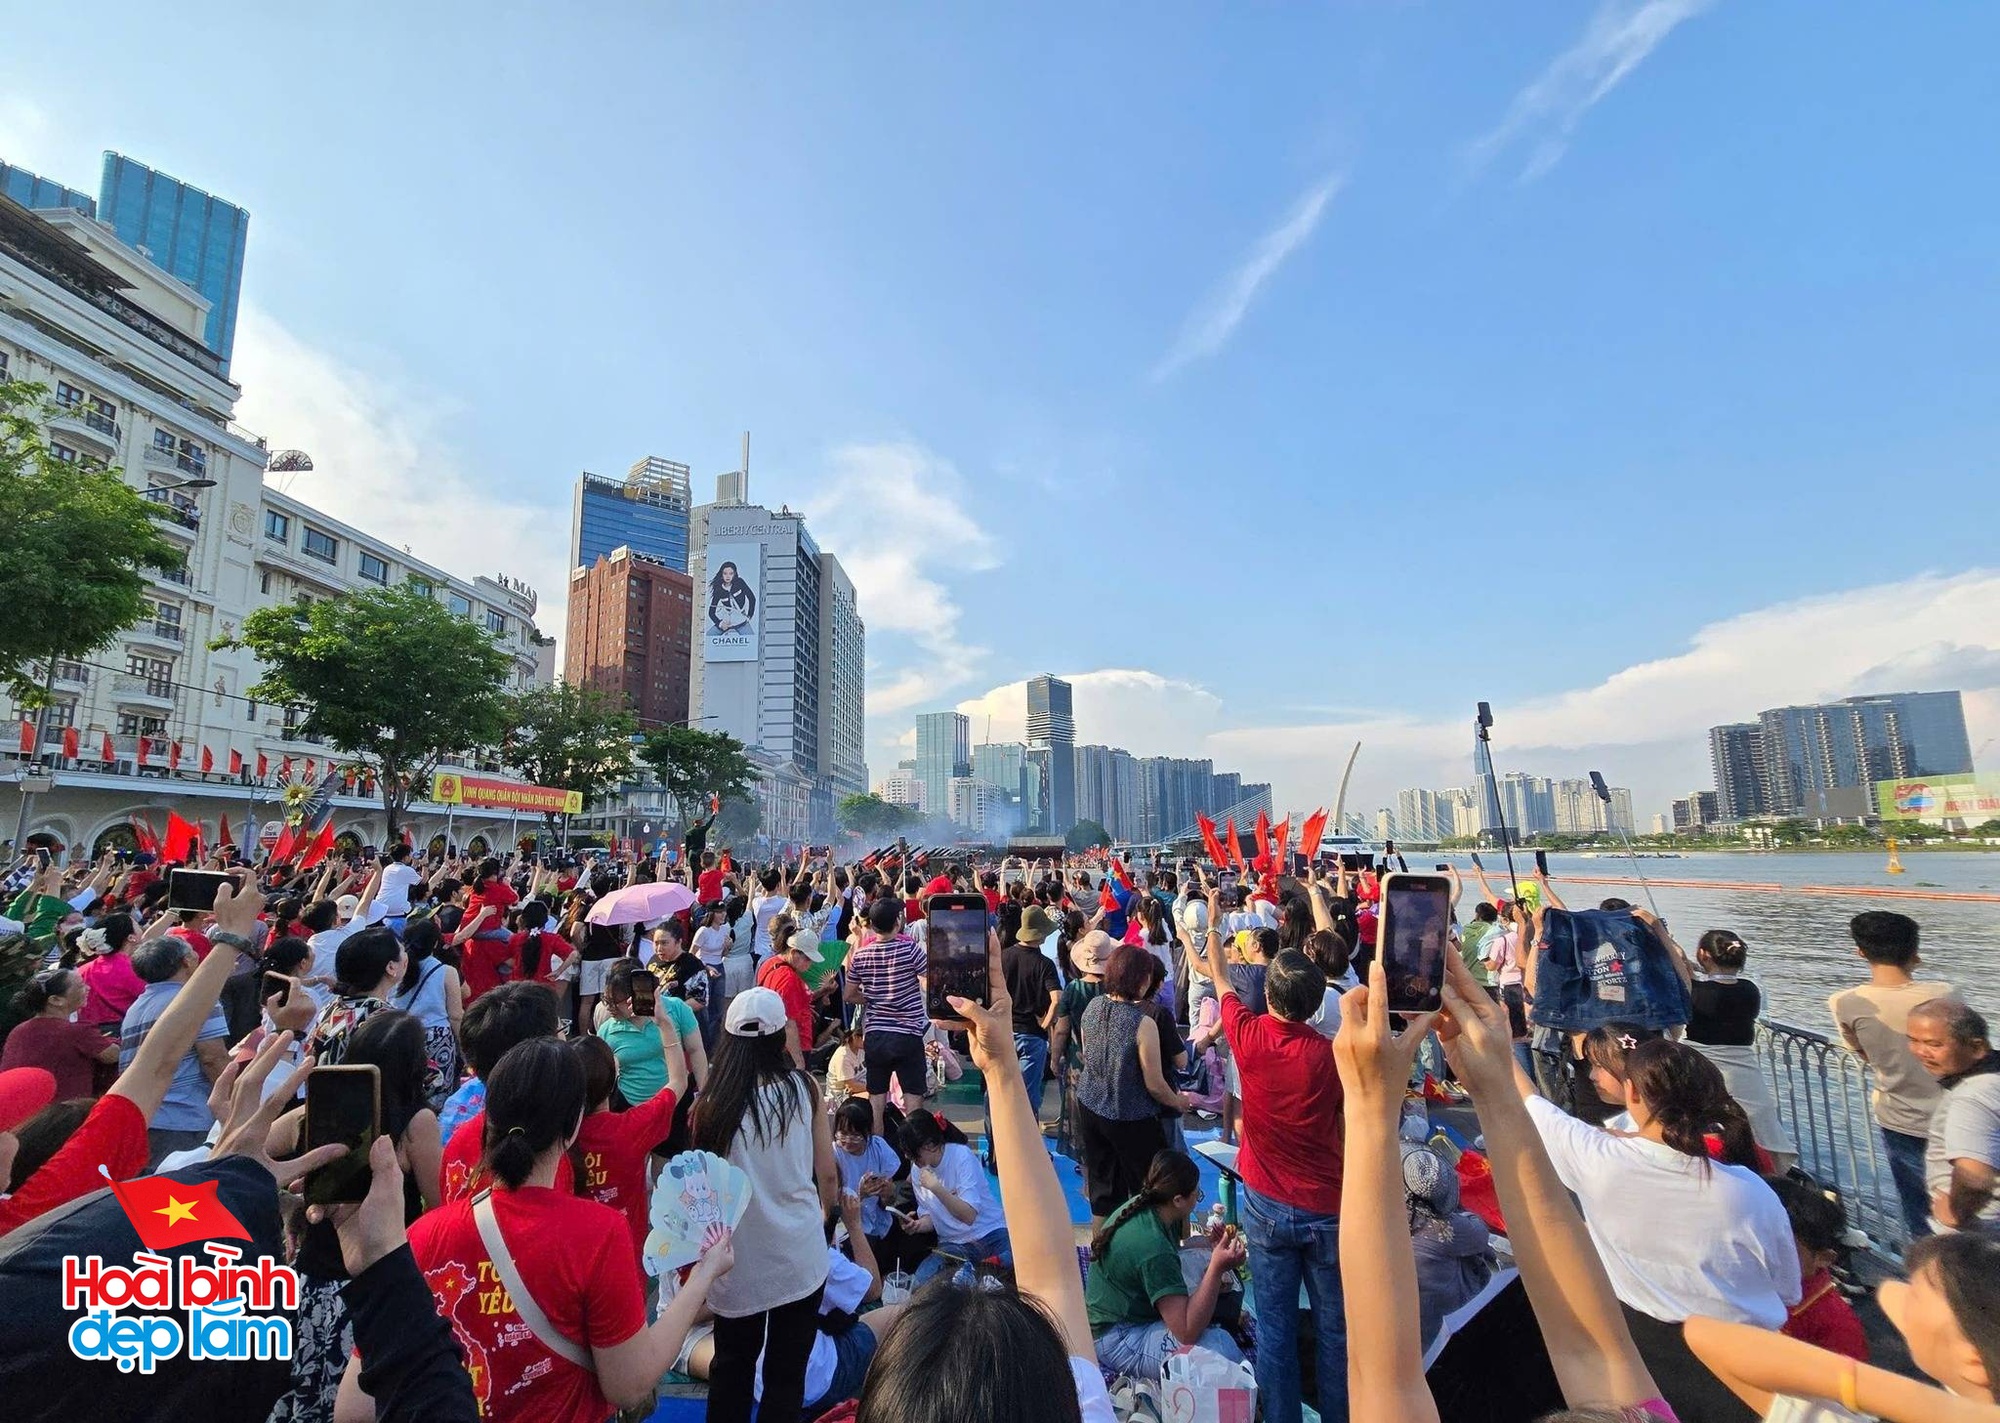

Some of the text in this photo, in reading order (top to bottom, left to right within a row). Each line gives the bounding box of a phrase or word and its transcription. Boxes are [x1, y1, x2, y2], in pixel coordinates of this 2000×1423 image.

[712, 637, 750, 645] CHANEL
[585, 1152, 602, 1169] ÔI
[586, 1169, 608, 1187] ÊU
